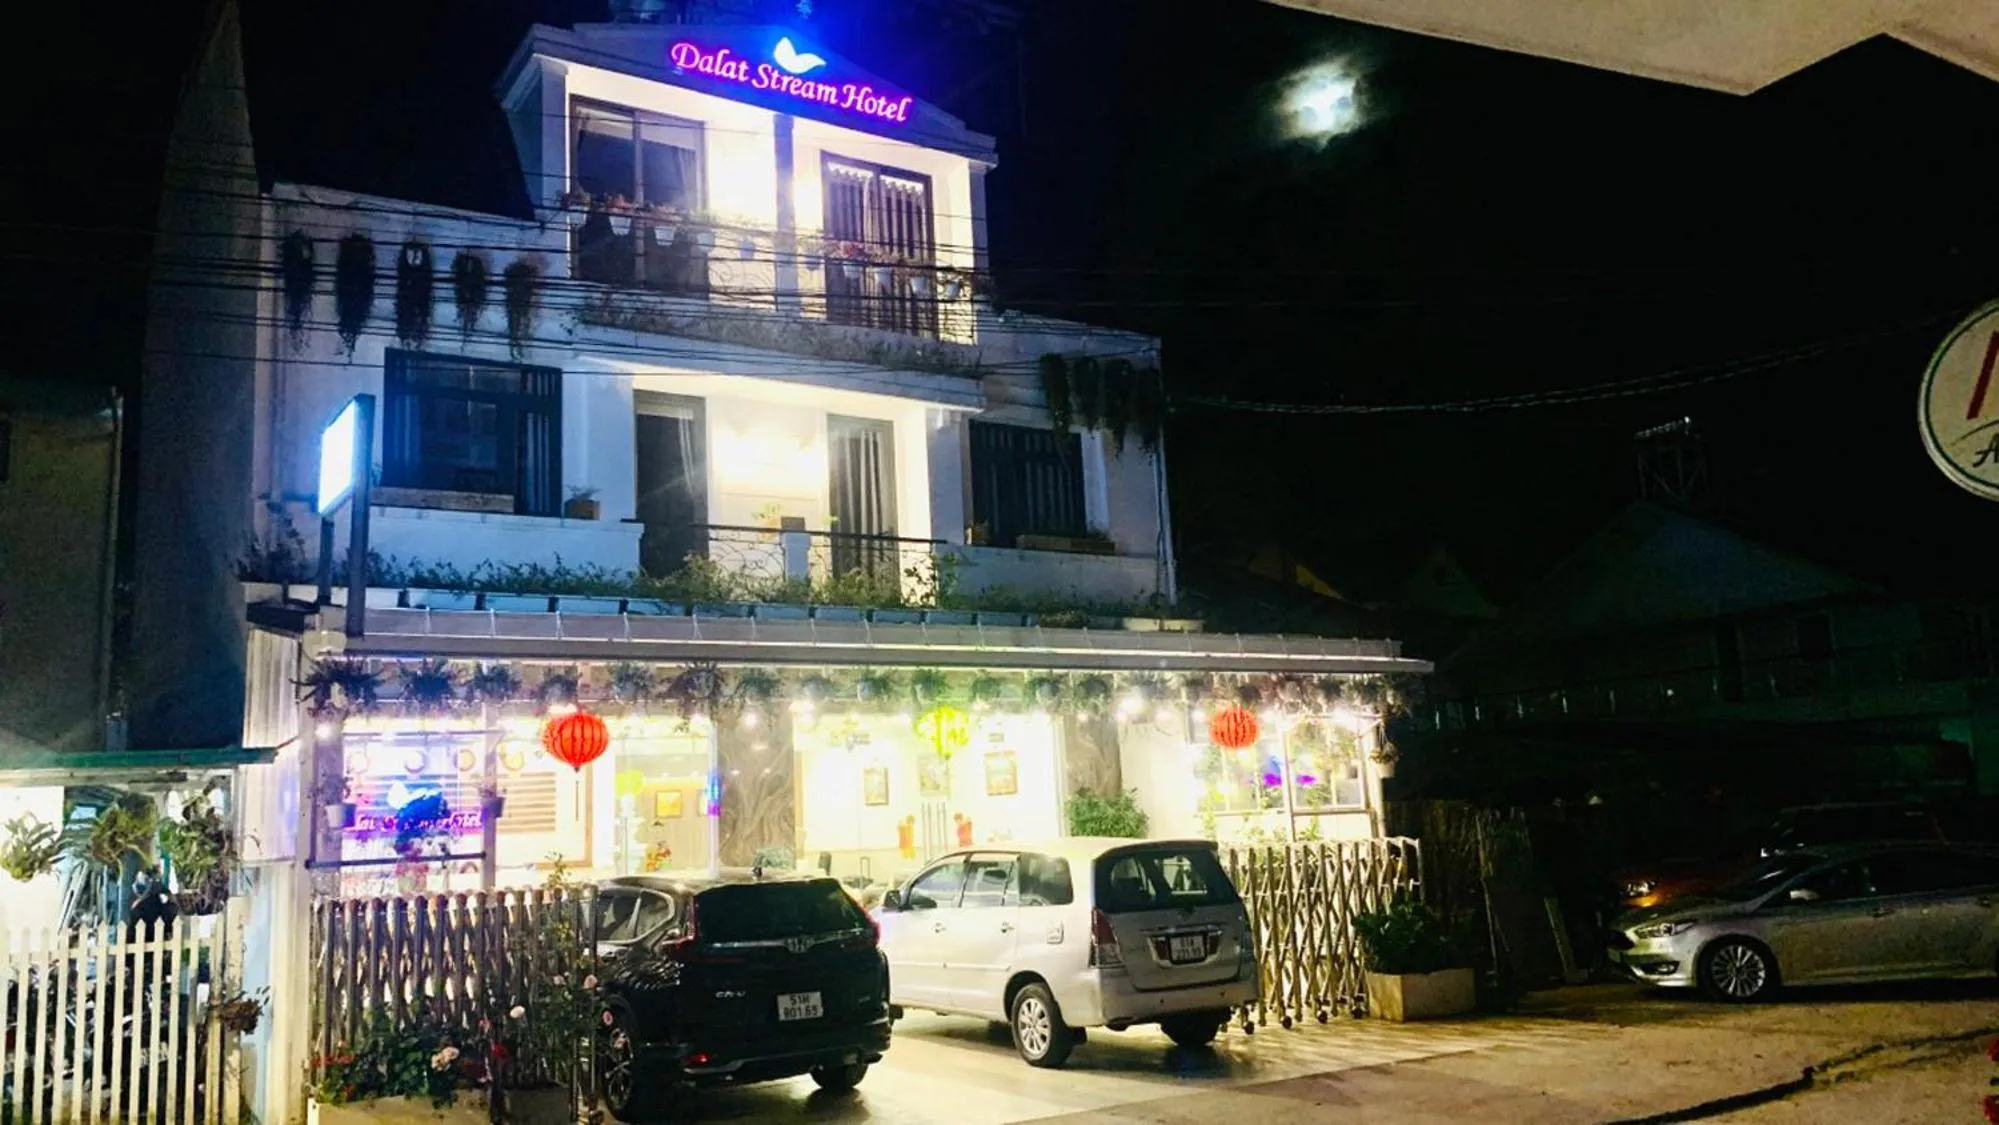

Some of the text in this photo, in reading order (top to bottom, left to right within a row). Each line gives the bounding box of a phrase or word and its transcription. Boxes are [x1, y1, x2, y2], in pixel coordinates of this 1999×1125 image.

[671, 43, 912, 122] Dalat Stream Hotel
